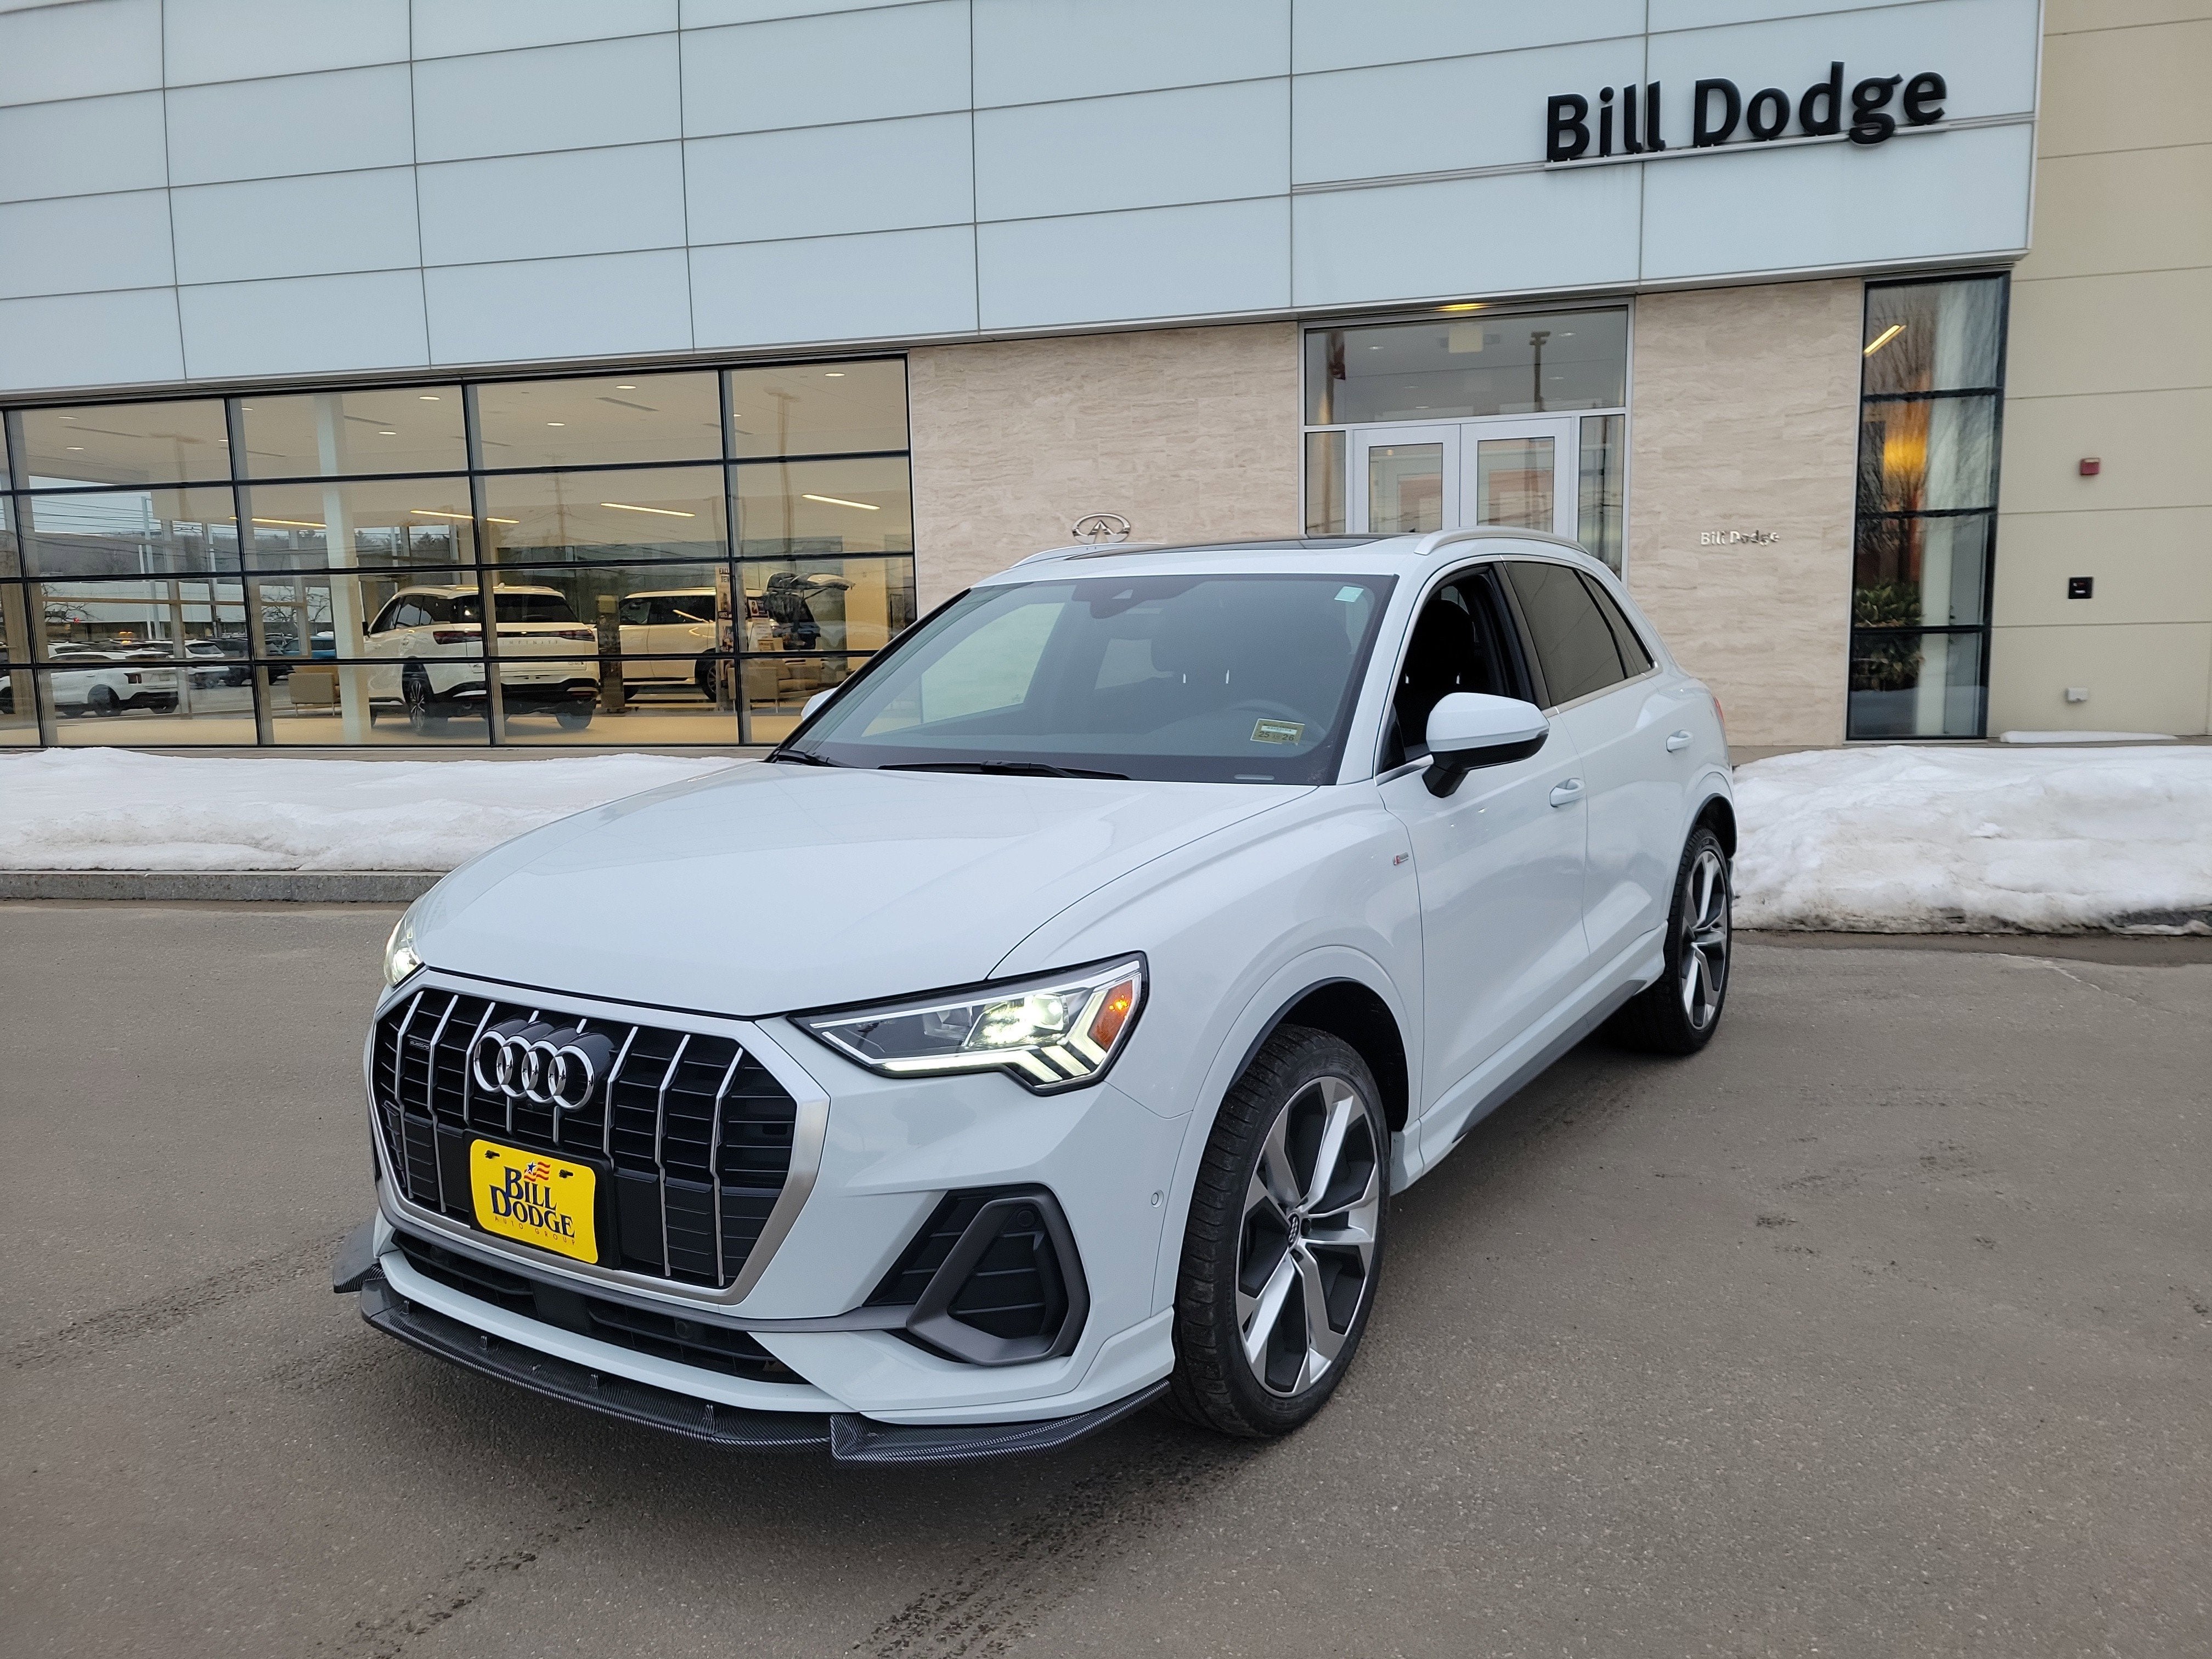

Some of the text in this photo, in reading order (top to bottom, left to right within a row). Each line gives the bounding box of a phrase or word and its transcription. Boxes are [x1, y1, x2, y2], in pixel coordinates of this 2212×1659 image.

[1547, 60, 1948, 161] Bill Dodge
[1701, 529, 1780, 546] Bill Dodge
[489, 1184, 575, 1238] DODGE
[504, 1166, 557, 1211] BILL
[494, 1215, 575, 1246] AUTO GROUP
